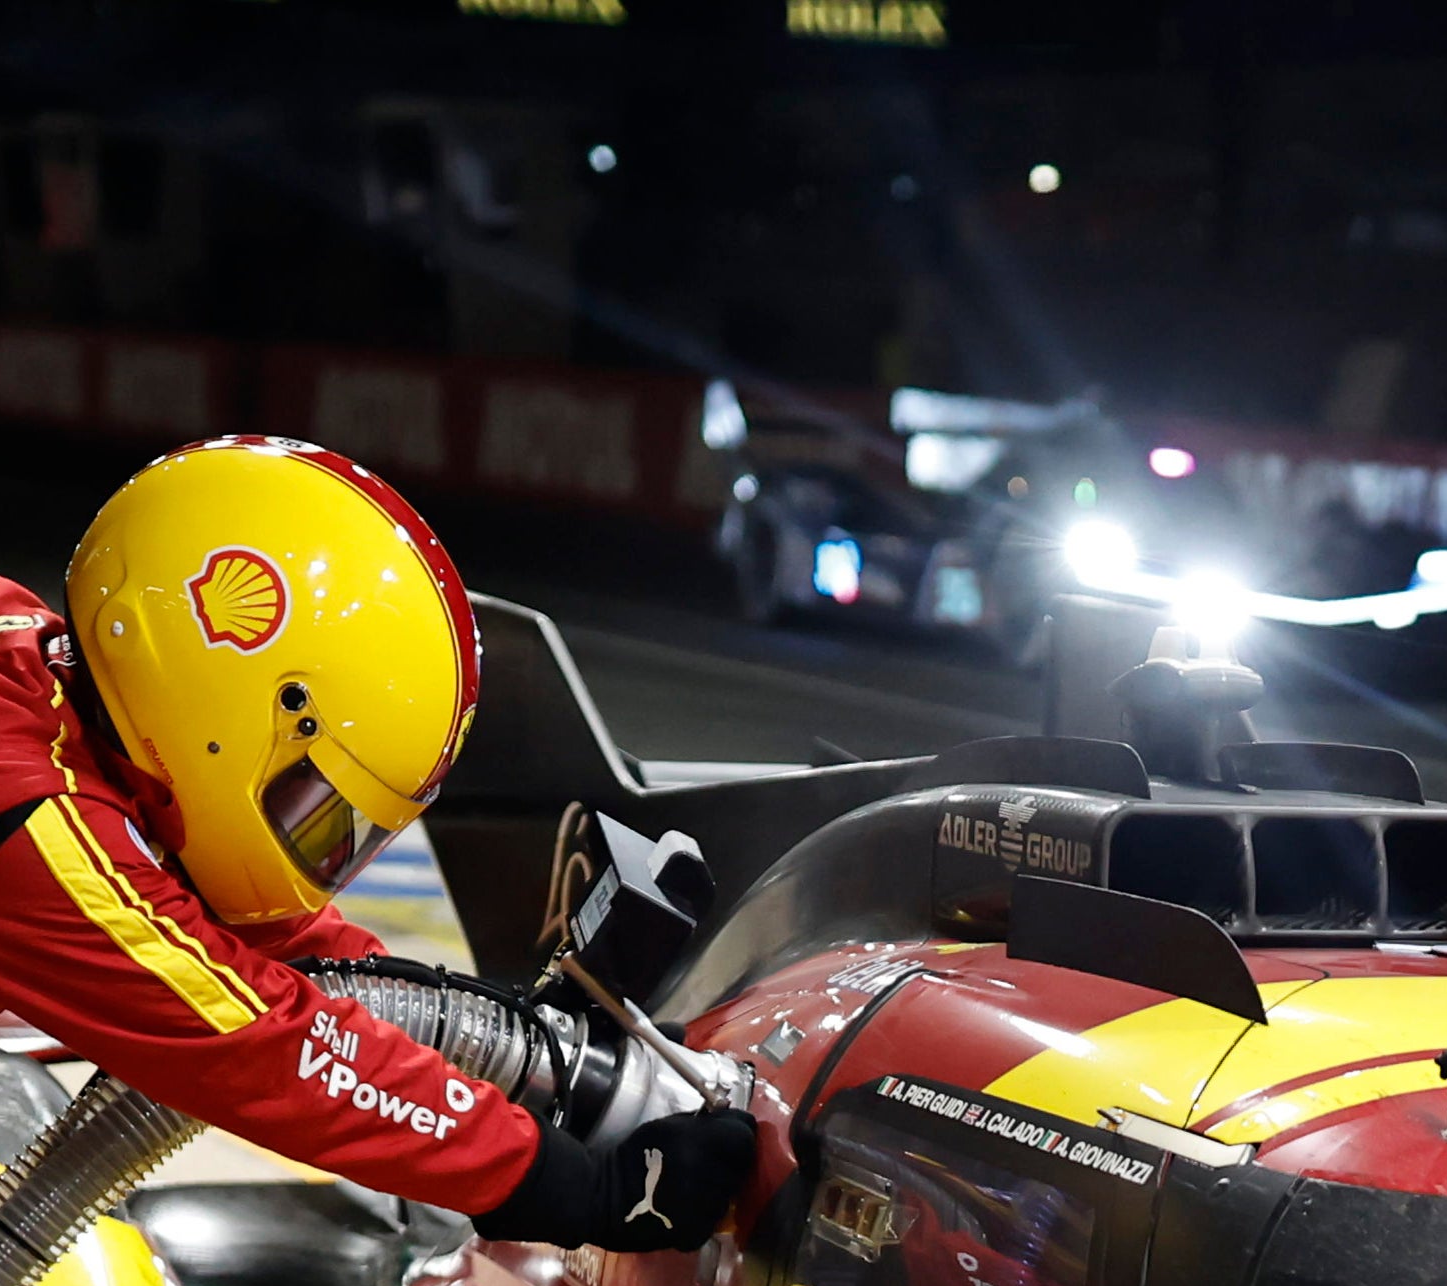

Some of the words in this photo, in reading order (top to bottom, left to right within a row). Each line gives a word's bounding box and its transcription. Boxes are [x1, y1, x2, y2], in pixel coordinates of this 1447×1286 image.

[938, 812, 998, 857] ADLER
[1026, 832, 1092, 877] GROUP
[309, 1010, 359, 1062] Shell
[297, 1038, 457, 1140] V-Power
[891, 1082, 904, 1101] A.
[903, 1082, 931, 1111] PIER
[930, 1093, 966, 1118] GUIDI
[988, 1113, 1044, 1146] CALADO
[1055, 1137, 1069, 1158] A.
[1068, 1142, 1154, 1185] GIOVINAZZI
